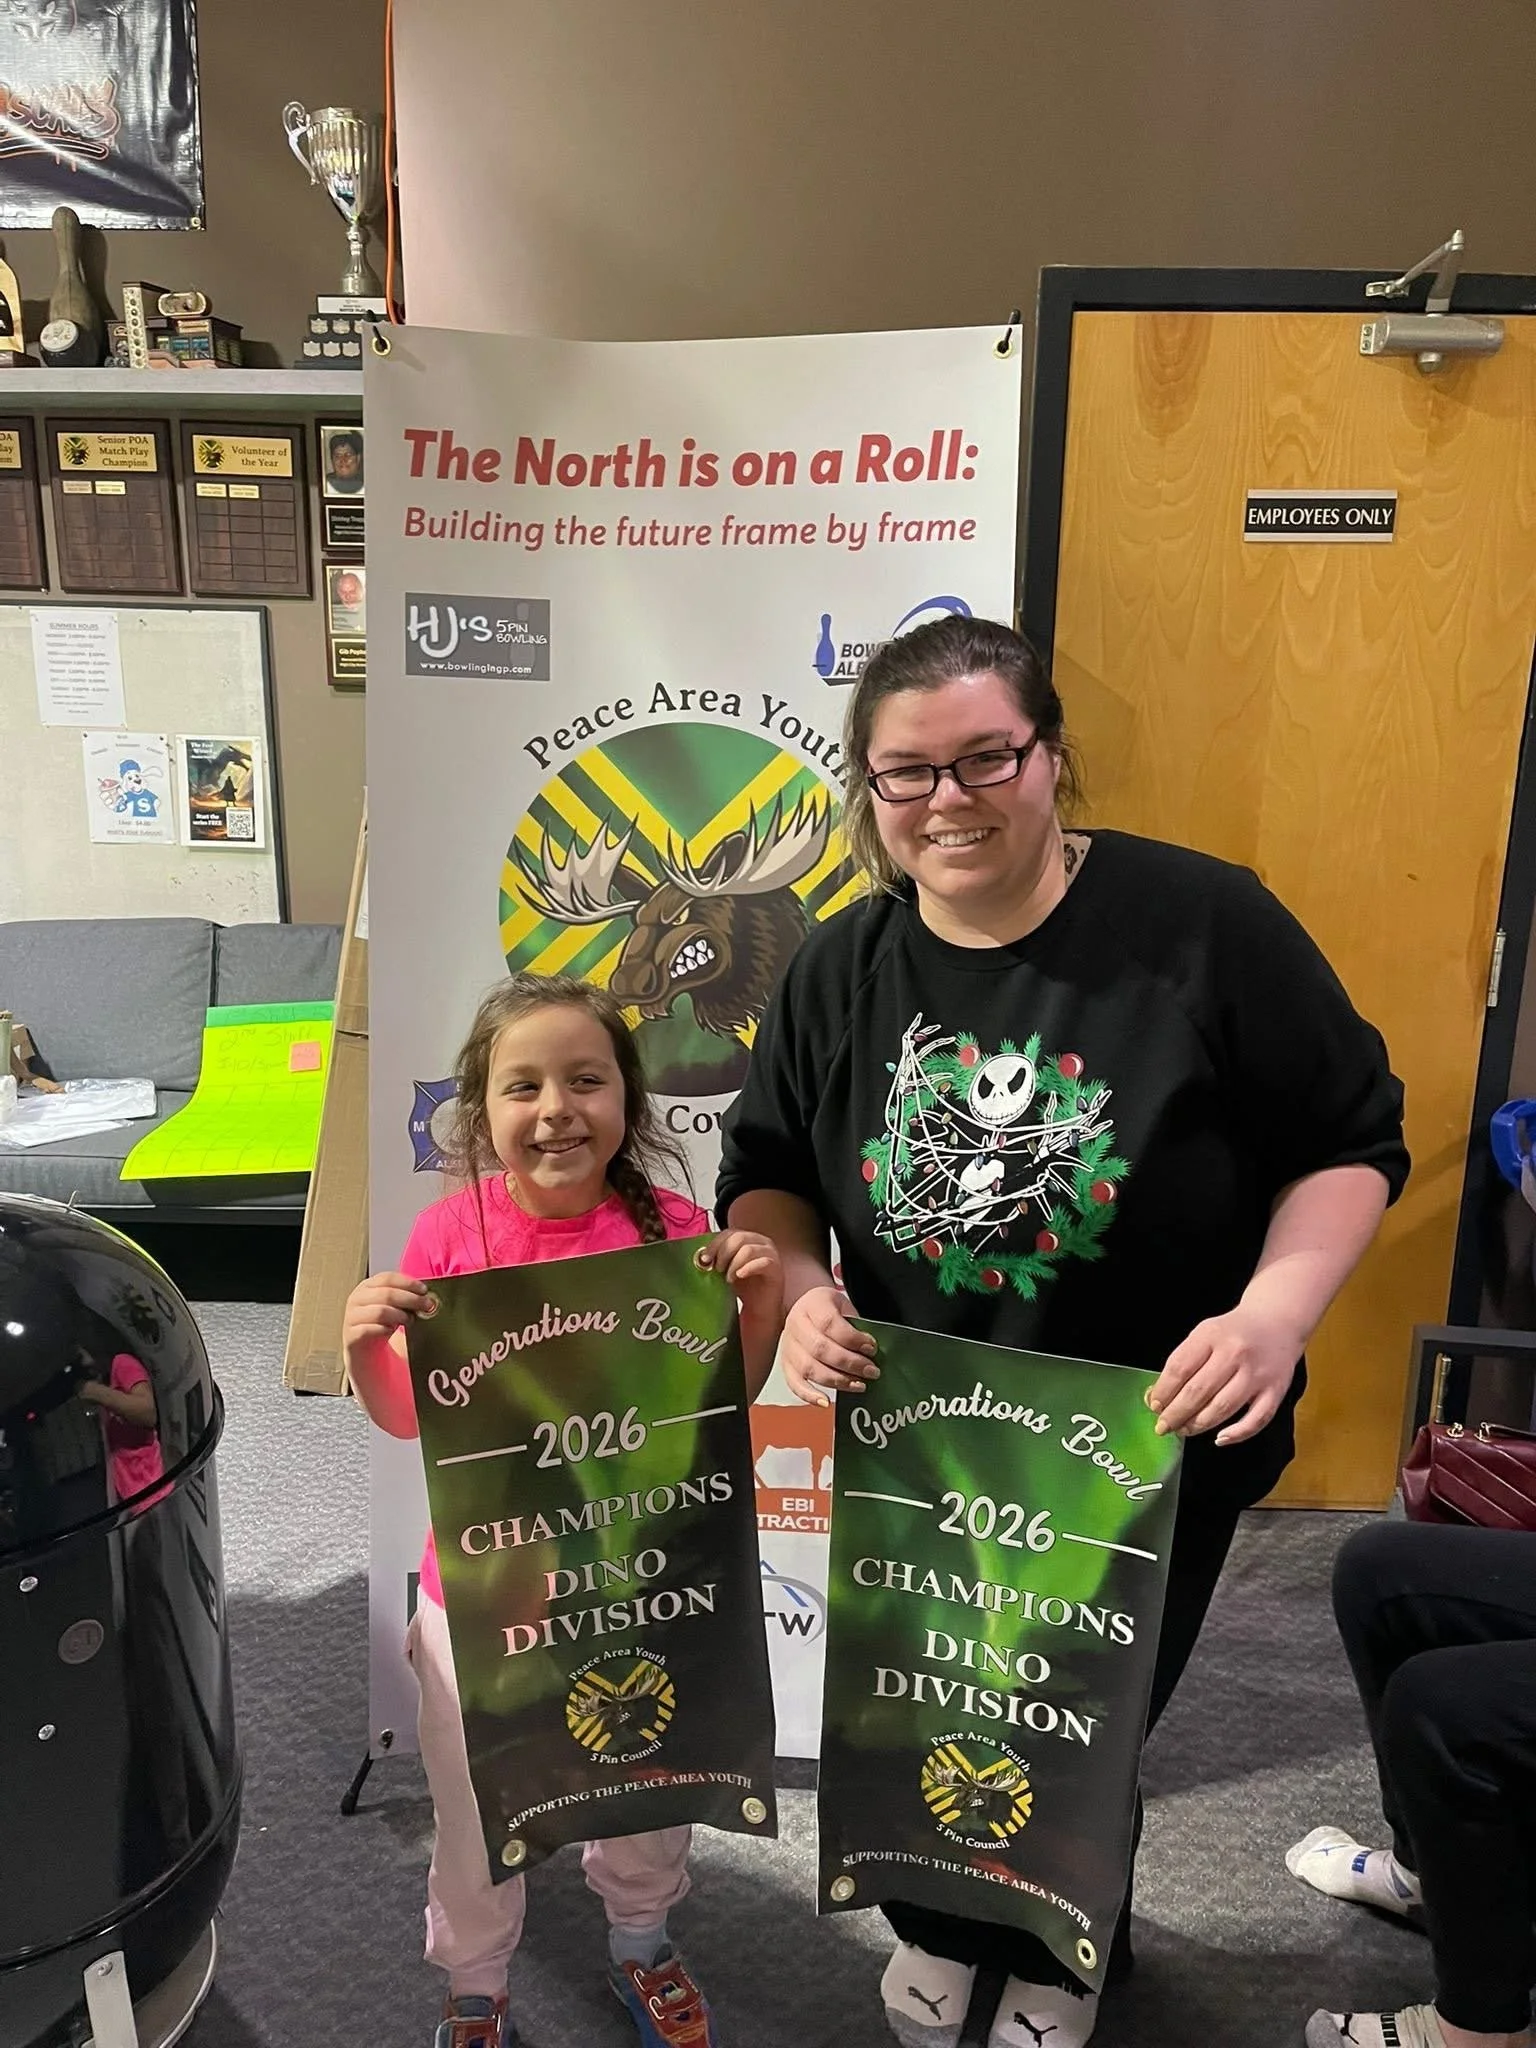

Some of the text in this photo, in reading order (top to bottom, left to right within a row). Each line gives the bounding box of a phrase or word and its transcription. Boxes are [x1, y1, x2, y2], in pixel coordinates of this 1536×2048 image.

[98, 436, 149, 445] Senior POA
[99, 448, 149, 457] Match Play
[102, 458, 148, 468] Champion
[232, 446, 288, 457] Volunteer of
[241, 459, 279, 467] the Year
[404, 429, 978, 488] The North is on a Roll:
[405, 507, 977, 551] Building the future frame by frame
[1248, 508, 1393, 525] EMPLOYEES ONLY
[496, 633, 547, 644] BOWLING
[420, 662, 532, 675] www.bowlingingp.com
[523, 698, 634, 770] Peace
[648, 682, 741, 716] Area
[428, 1298, 728, 1407] Generations Bowl
[532, 1405, 648, 1469] 2026
[850, 1381, 1164, 1501] Generations Bowl
[460, 1472, 734, 1556] CHAMPIONS
[782, 1497, 815, 1512] EBI
[938, 1490, 1057, 1553] 2026
[543, 1548, 667, 1601] DINO
[501, 1583, 717, 1656] DIVISION
[852, 1558, 1135, 1645] CHAMPIONS
[569, 1647, 667, 1680] Peace Area Youth
[922, 1628, 1051, 1683] DINO
[872, 1667, 1098, 1747] DIVISION
[590, 1740, 663, 1764] 5 Pin Council
[930, 1731, 1031, 1773] Peace Area Youth
[508, 1772, 752, 1832] SUPPORTING THE PEACE AREA YOUTH
[936, 1823, 1010, 1850] 5 Pin Council
[842, 1851, 1092, 1932] SUPPORTING THE PEACE AREA YOUTH
